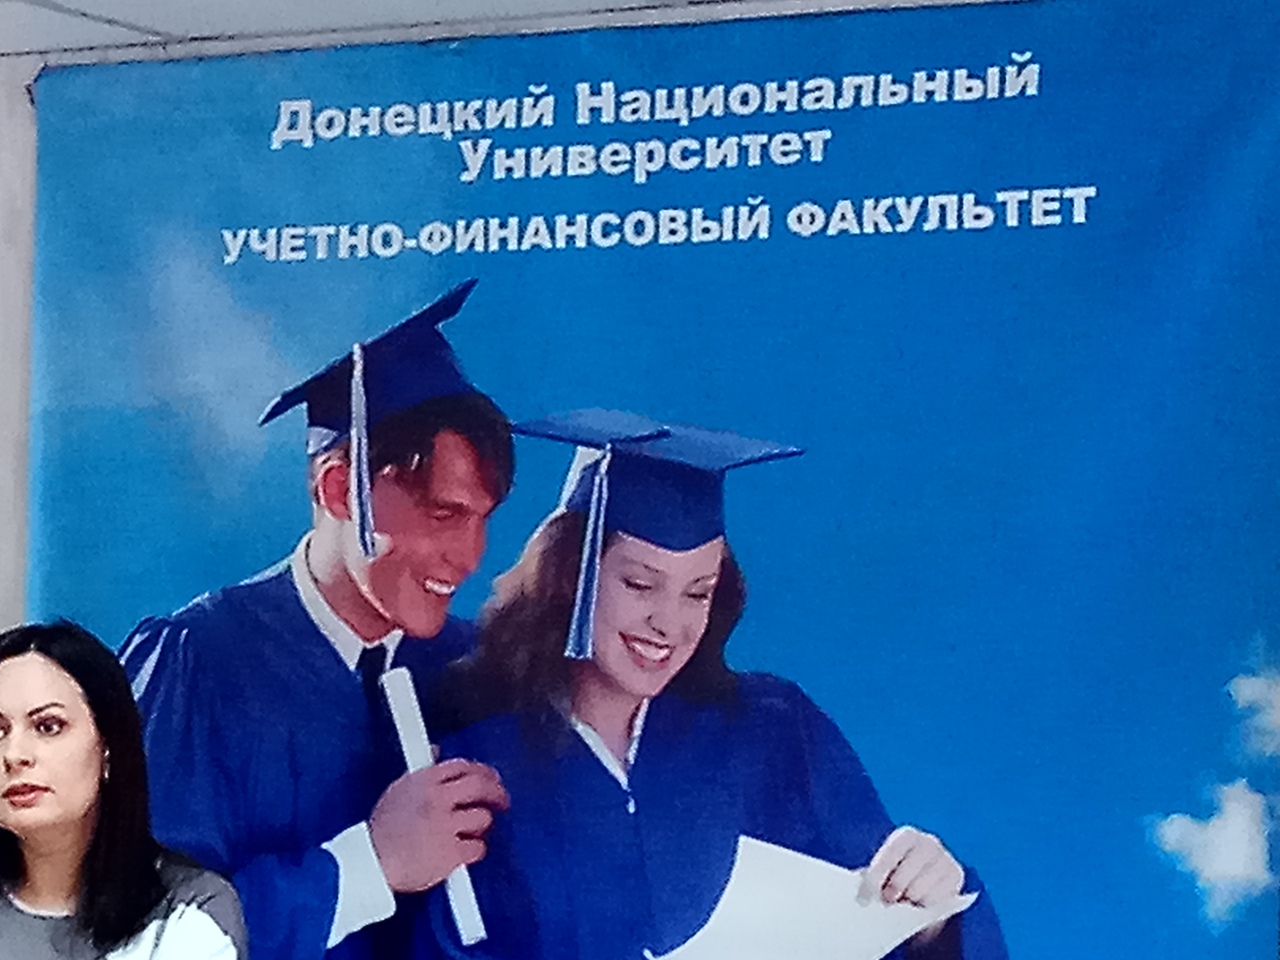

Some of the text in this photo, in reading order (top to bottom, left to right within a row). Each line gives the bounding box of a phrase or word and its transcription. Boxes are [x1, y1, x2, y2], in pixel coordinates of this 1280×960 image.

[269, 50, 1041, 151] Донецкий Национальный
[458, 129, 833, 184] Университет
[220, 185, 1098, 266] УЧЕТНО-ФИНАНСОВЫЙ ФАКУЛЬТЕТ
